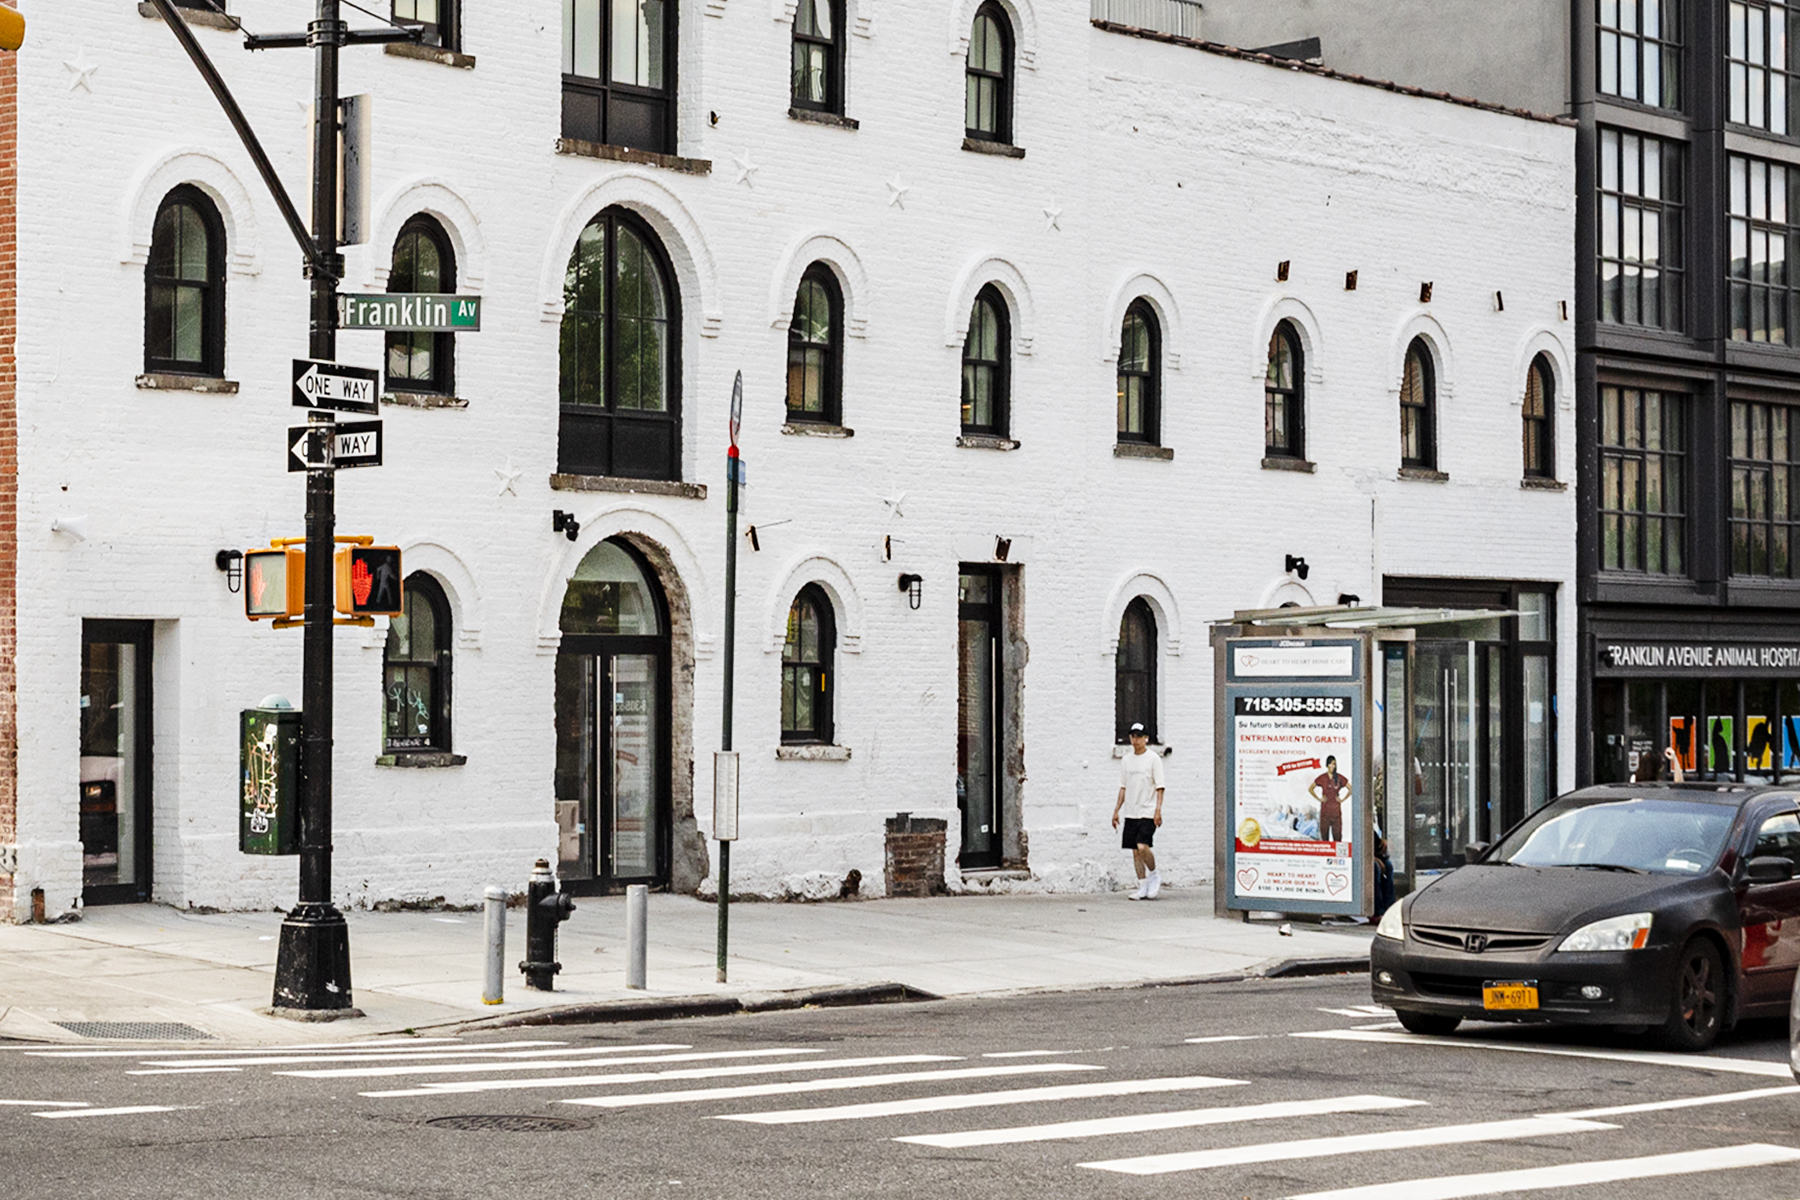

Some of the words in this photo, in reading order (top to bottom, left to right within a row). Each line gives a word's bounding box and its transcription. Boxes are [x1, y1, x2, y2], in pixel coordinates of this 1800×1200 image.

[345, 297, 447, 326] Franklin
[458, 300, 476, 317] Av
[306, 375, 331, 396] ONE
[342, 380, 369, 400] WAY
[341, 435, 370, 455] WAY
[1667, 647, 1713, 667] AVENUE
[1715, 648, 1759, 668] ANIMAL
[1243, 697, 1344, 712] 718-305-5555
[1250, 721, 1272, 729] futuro
[1240, 735, 1312, 743] ENTRENAMIENTO
[1314, 736, 1347, 744] GRATIS
